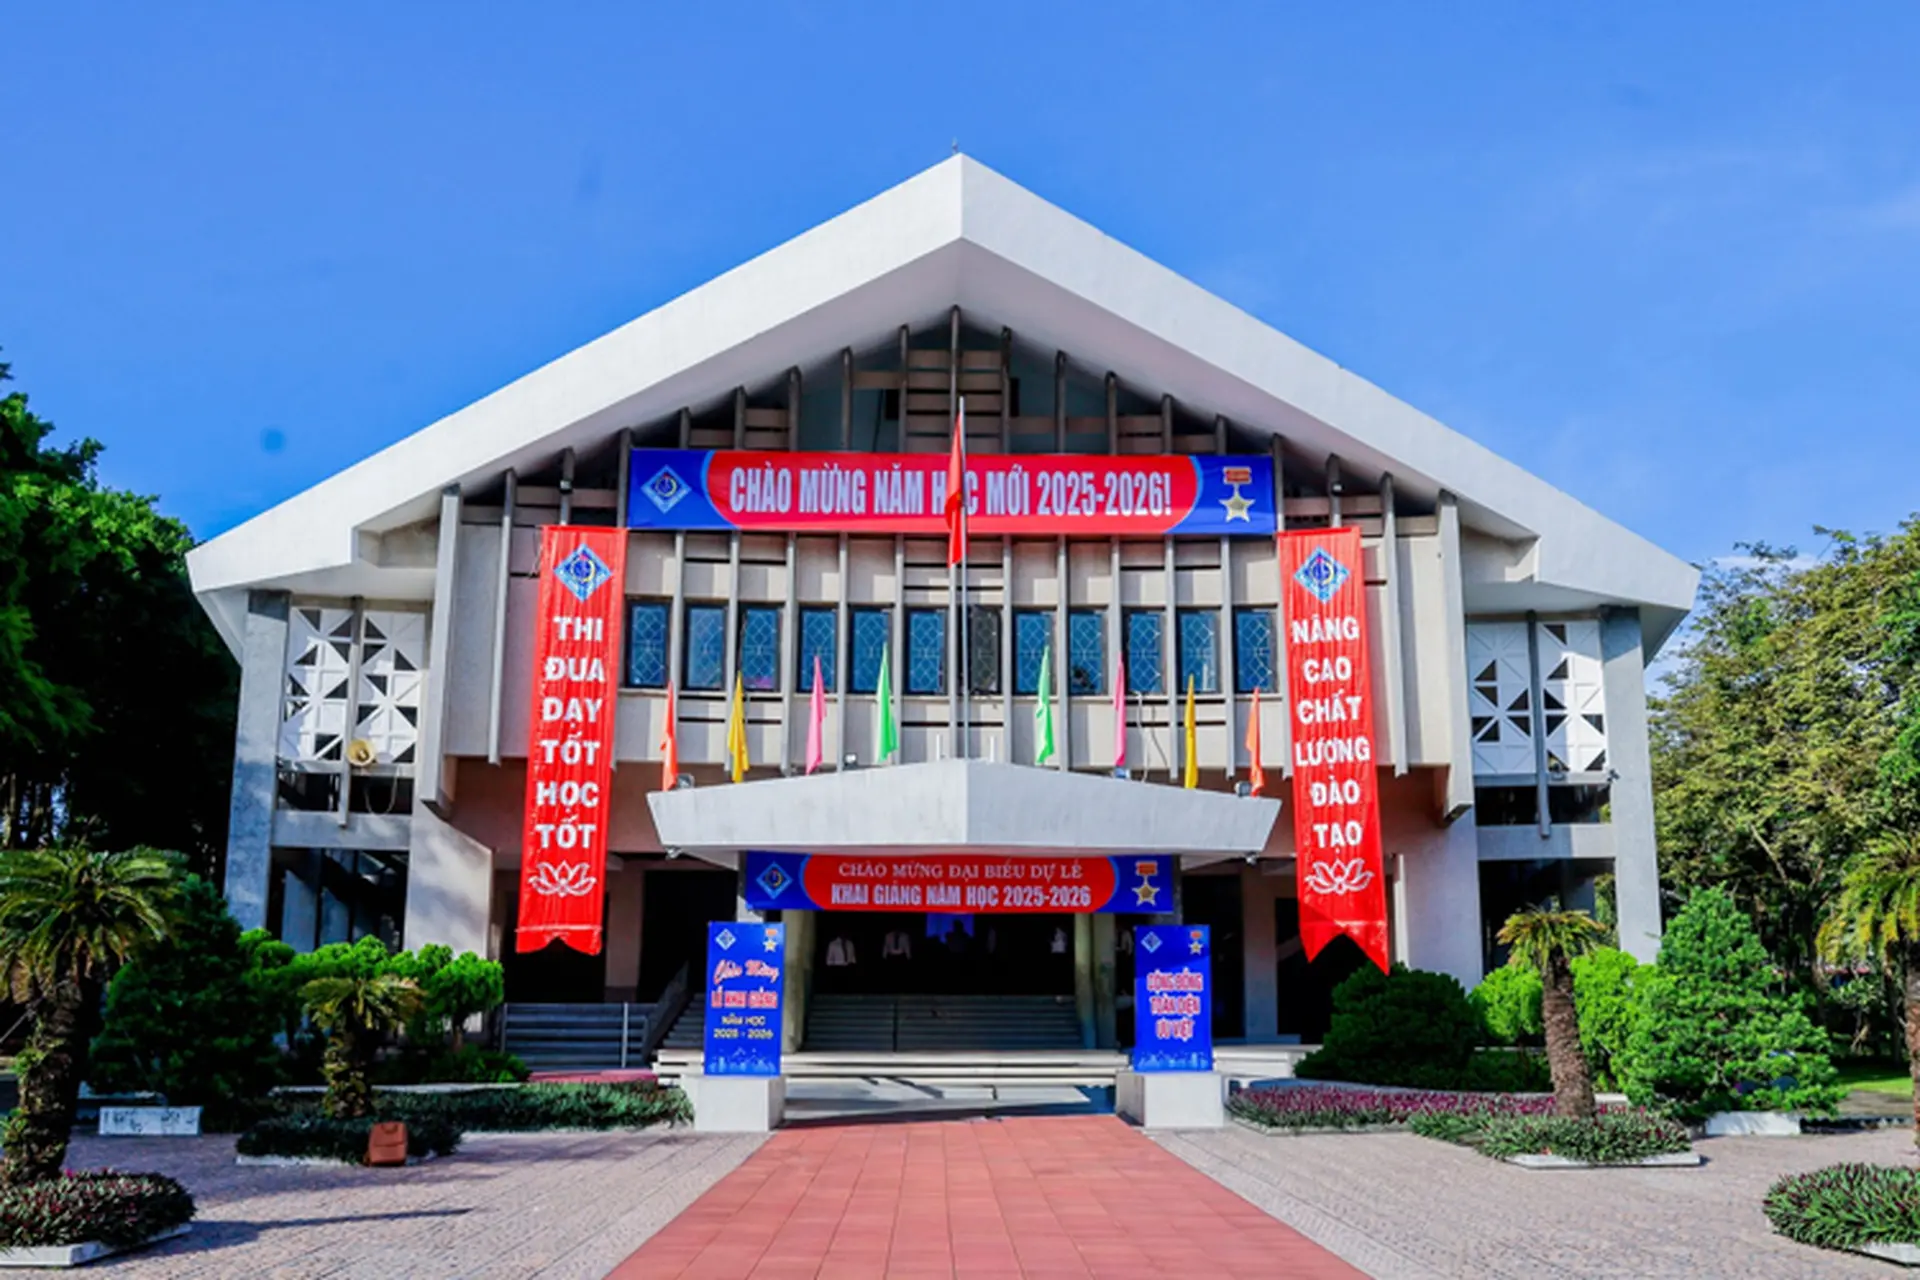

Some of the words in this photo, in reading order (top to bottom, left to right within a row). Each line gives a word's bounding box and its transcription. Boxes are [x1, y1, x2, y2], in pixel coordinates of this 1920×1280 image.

[729, 461, 792, 514] CHÀO
[799, 463, 867, 515] MỪNG
[873, 463, 924, 515] NĂM
[931, 471, 979, 515] HC
[986, 463, 1030, 516] MỚI
[1037, 471, 1172, 516] 2025-2026!
[553, 616, 604, 641] THI
[1292, 613, 1360, 643] NÂNG
[545, 656, 606, 682] ĐUA
[1303, 656, 1352, 684] CAO
[542, 697, 603, 728] DẠY
[1297, 688, 1362, 724] CHẤT
[540, 731, 601, 766] TỐT
[1295, 736, 1370, 770] LƯỢNG
[536, 780, 600, 813] HỌC
[1309, 775, 1360, 807] ĐÀO
[535, 814, 597, 849] TỐT
[1312, 820, 1363, 854] TẠO
[838, 860, 887, 877] CHÀO
[892, 860, 943, 878] MỪNG
[949, 864, 979, 882] ĐẠI
[1030, 862, 1056, 883] DỰ
[831, 883, 869, 904] KHAI
[873, 879, 922, 906] GIẢNG
[926, 881, 961, 906] NĂM
[966, 885, 999, 911] HỌC
[1003, 885, 1092, 907] 2025-2026
